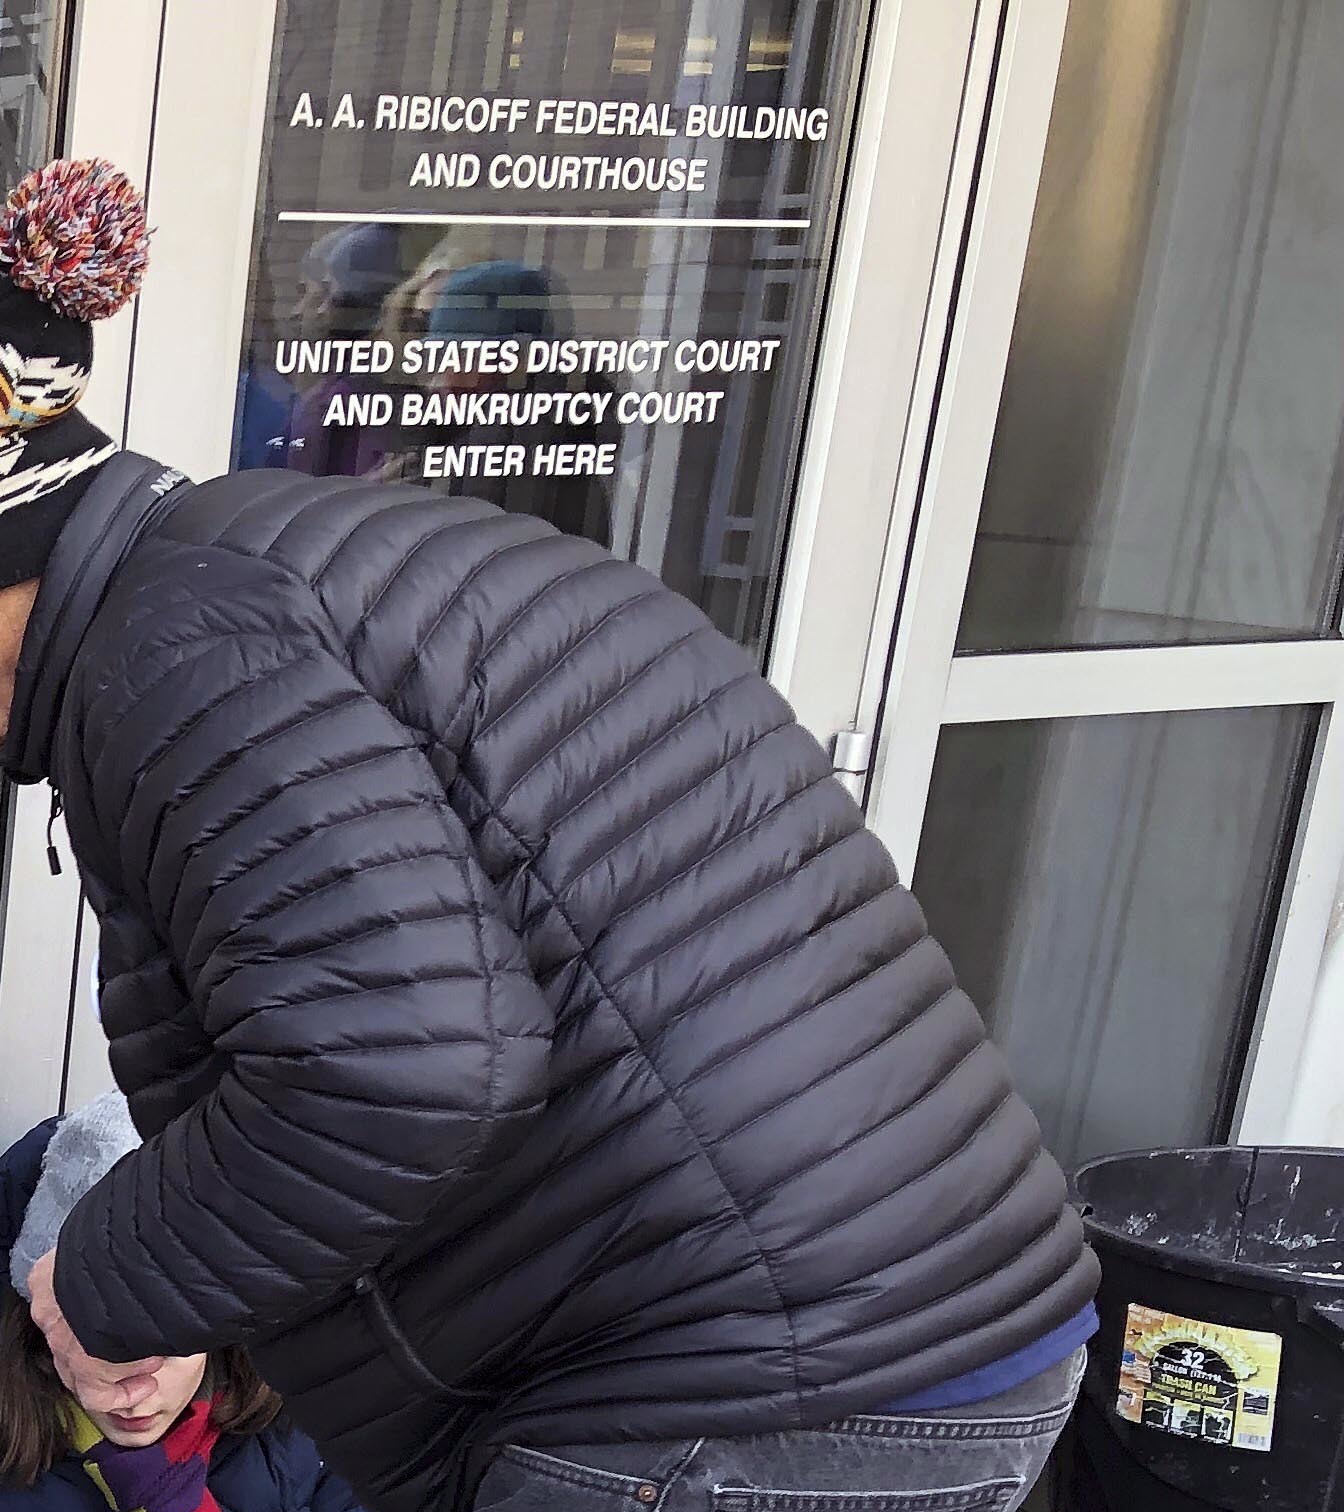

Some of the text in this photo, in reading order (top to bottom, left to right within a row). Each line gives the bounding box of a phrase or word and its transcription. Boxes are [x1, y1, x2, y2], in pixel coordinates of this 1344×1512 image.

[289, 92, 830, 141] A. A. RIBICOFF FEDERAL BUILDING
[409, 152, 709, 192] AND COURTHOUSE
[275, 340, 781, 374] UNITED STATES DISTRICT COURT
[322, 391, 724, 427] AND BANKRUPTCY COURT
[422, 443, 617, 478] ENTER HERE
[1180, 1348, 1206, 1371] 32
